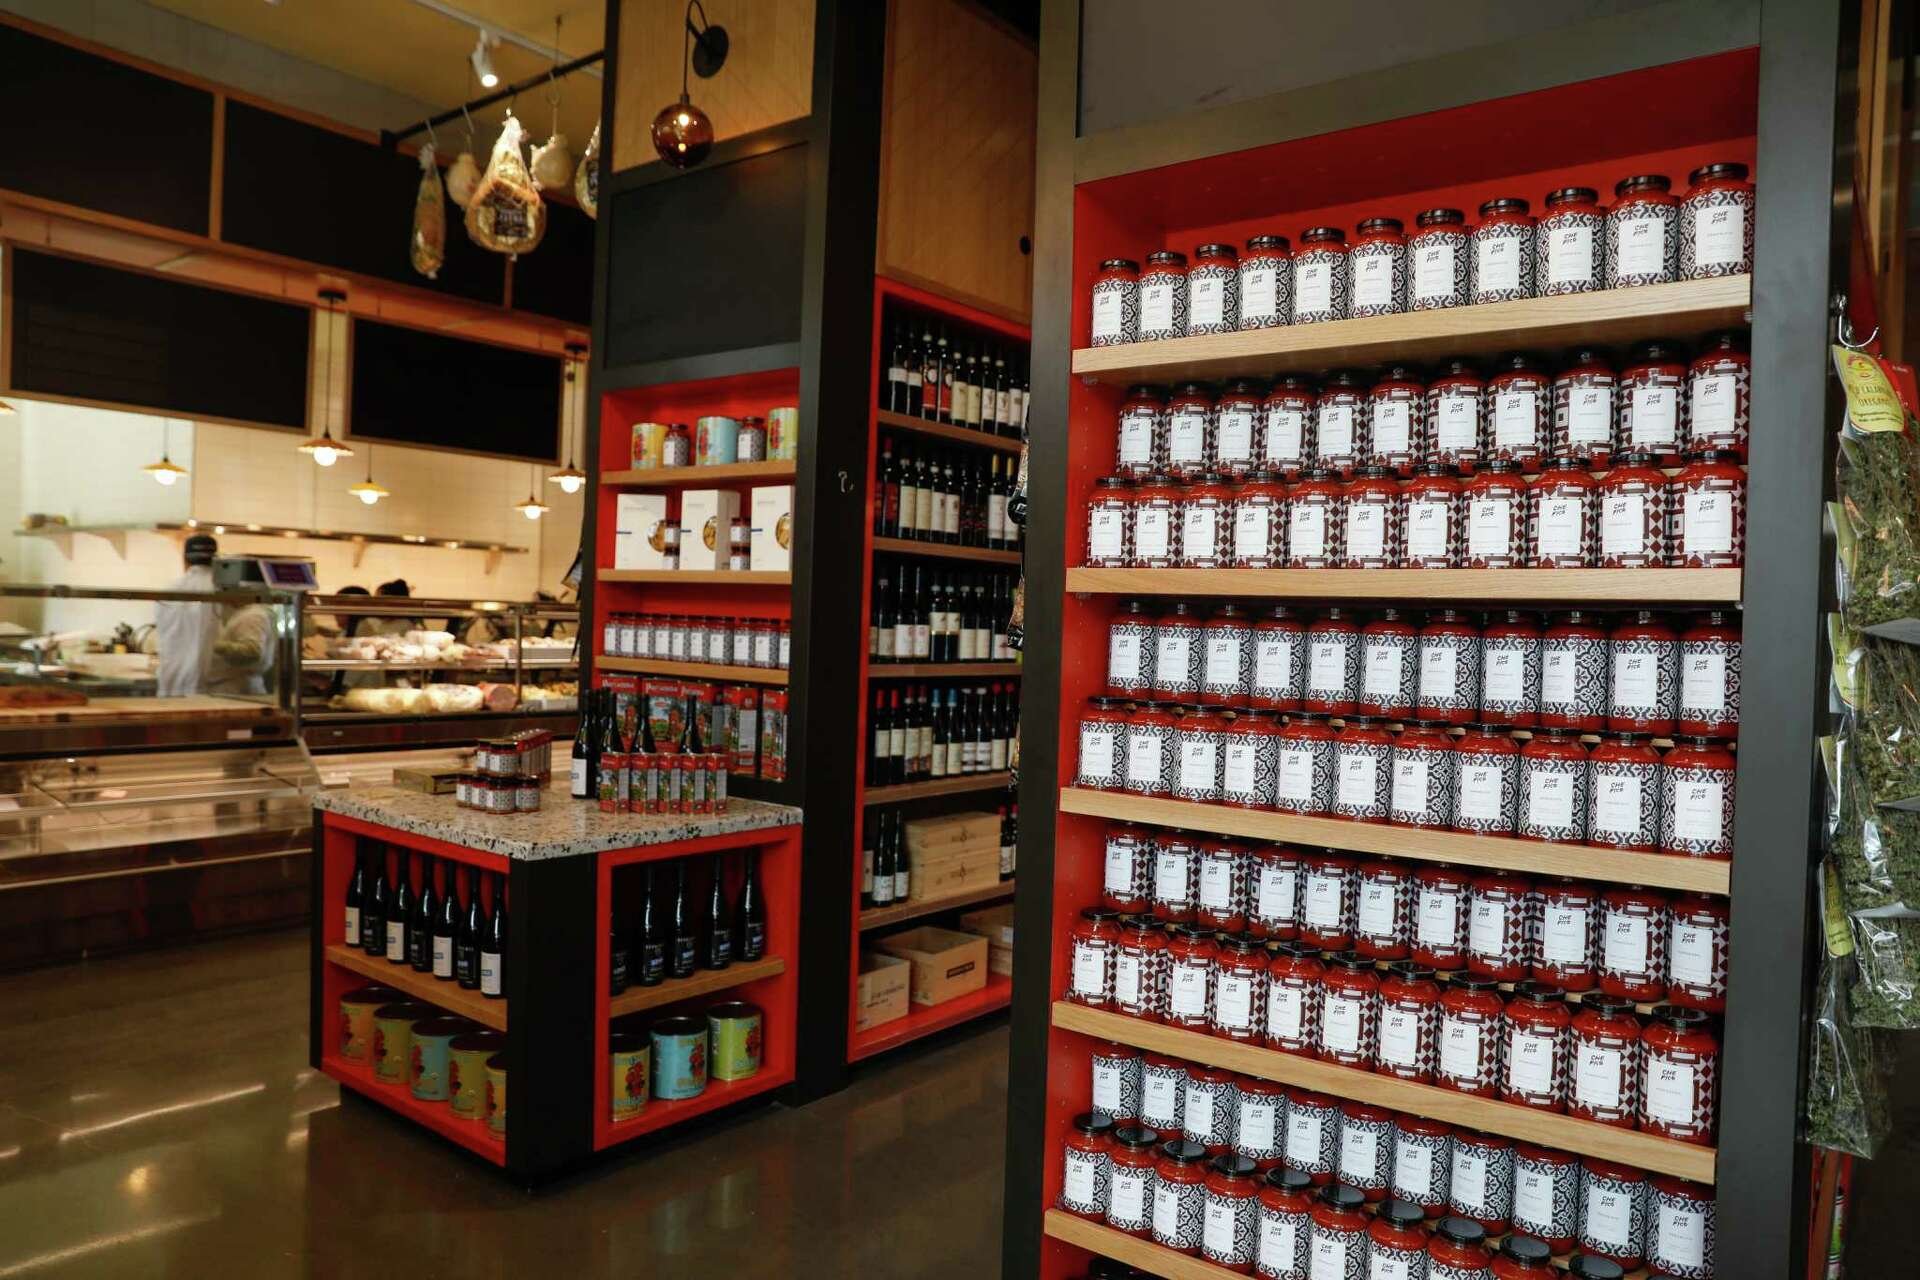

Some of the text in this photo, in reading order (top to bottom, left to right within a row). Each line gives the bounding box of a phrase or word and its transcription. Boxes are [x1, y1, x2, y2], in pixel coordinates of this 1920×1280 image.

[1712, 211, 1729, 219] CHE
[1635, 223, 1649, 231] CHE
[1705, 382, 1719, 390] CHE
[1647, 393, 1662, 401] CHE
